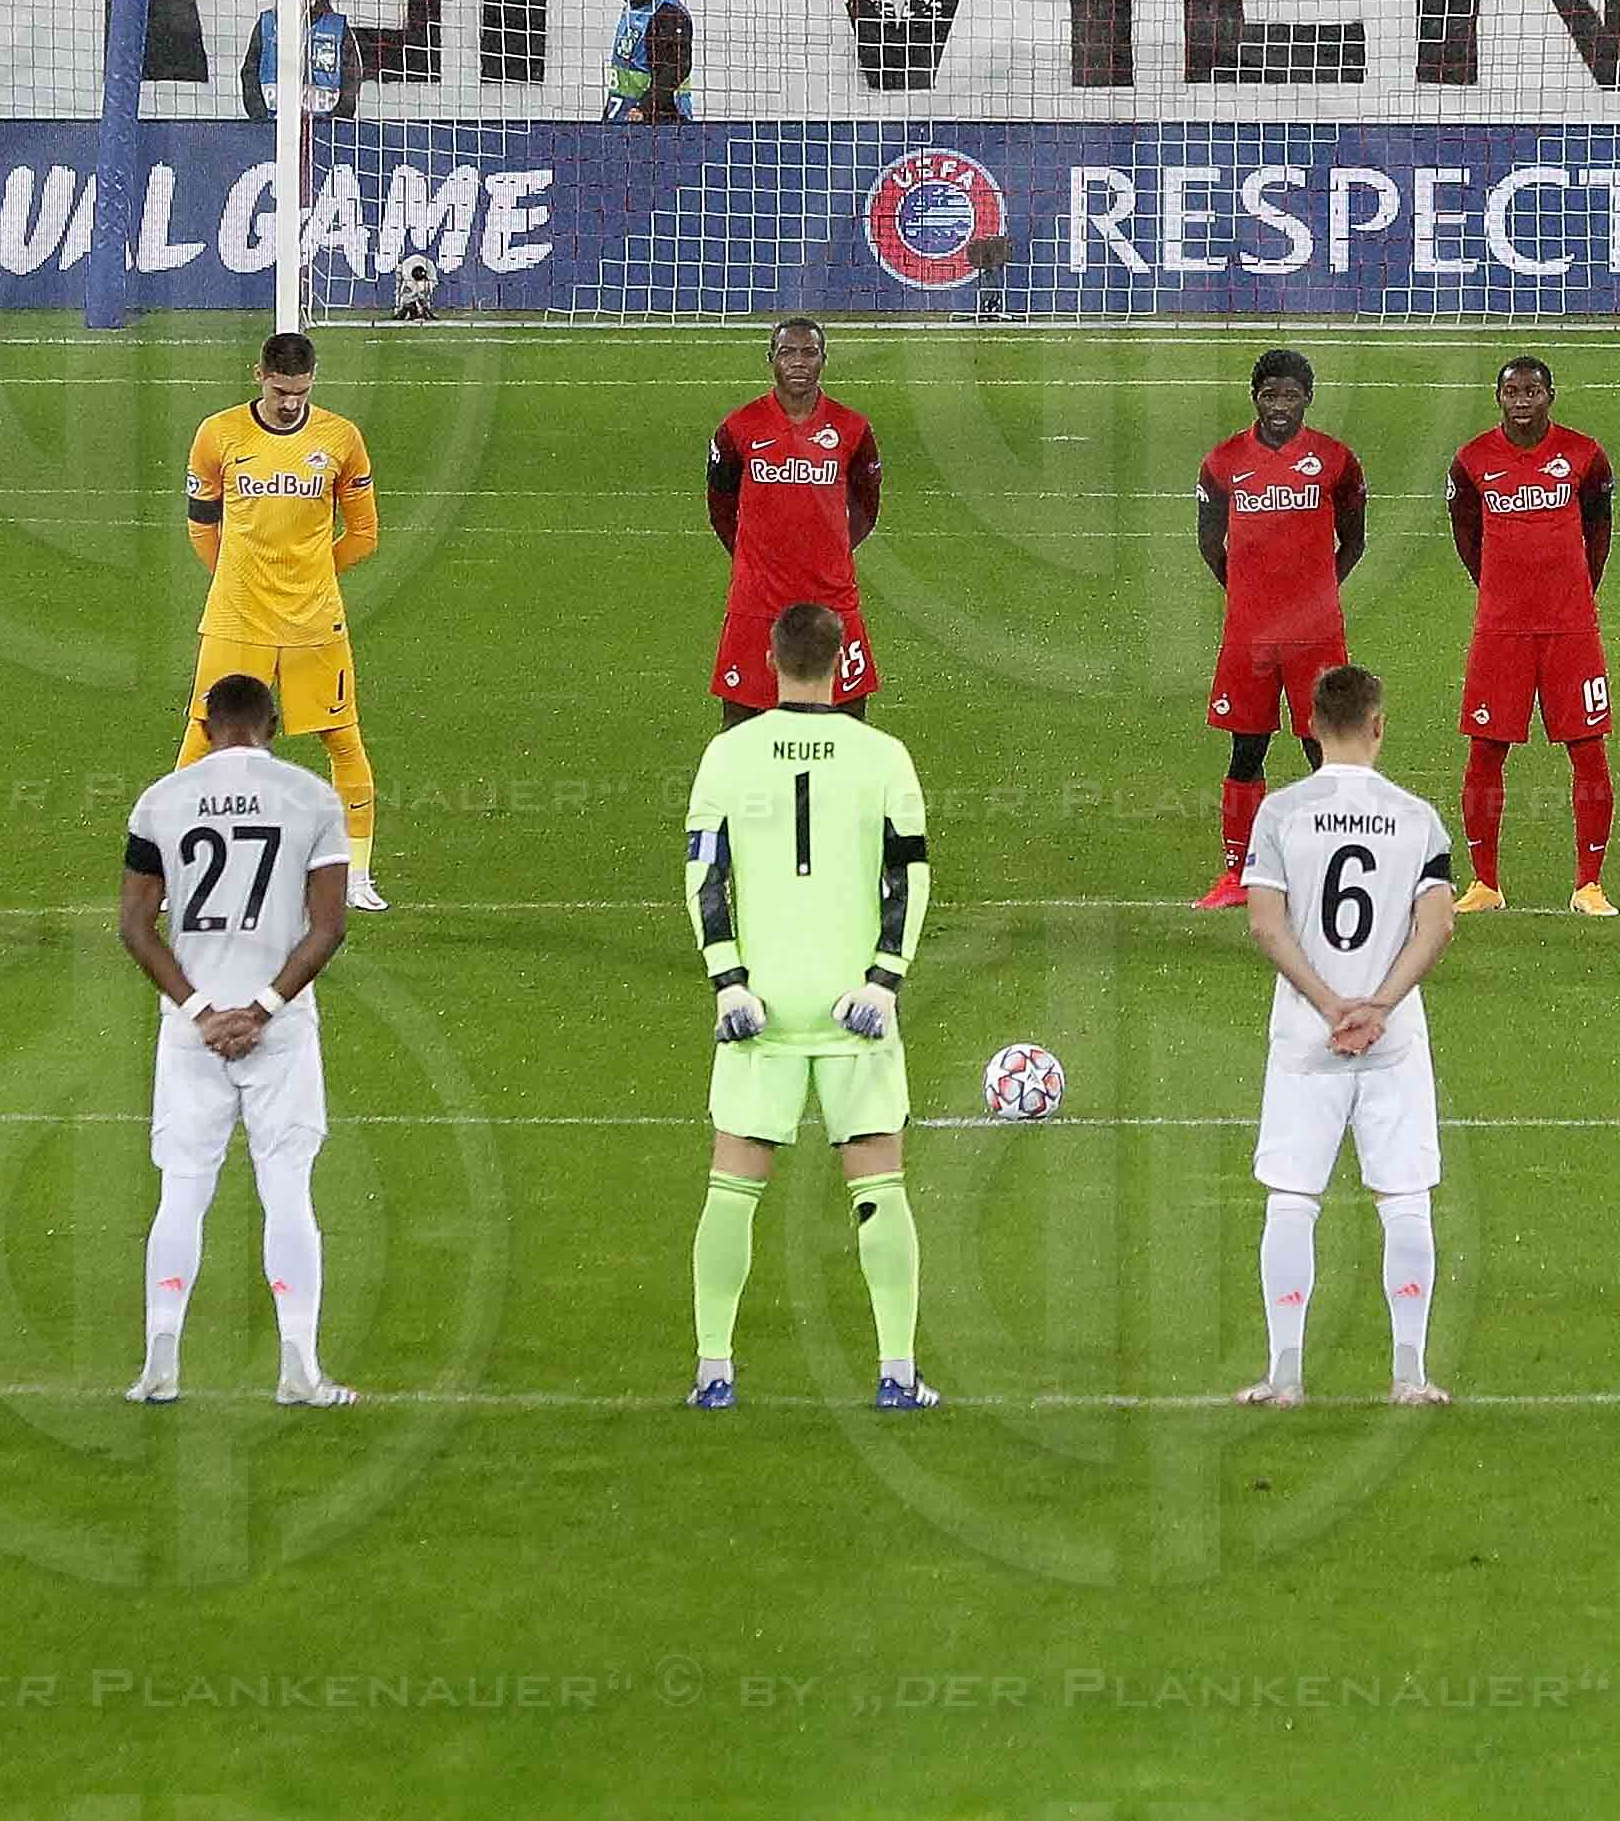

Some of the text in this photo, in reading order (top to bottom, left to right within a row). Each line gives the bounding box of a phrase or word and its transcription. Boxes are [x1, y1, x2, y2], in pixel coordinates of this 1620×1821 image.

[892, 157, 976, 191] UEFA
[336, 668, 345, 703] 1
[1581, 675, 1610, 713] 19
[772, 740, 836, 761] NEUER
[197, 795, 261, 817] ALABA
[793, 770, 812, 877] 1
[1313, 811, 1397, 837] KIMMICH
[180, 825, 282, 932] 27
[1320, 843, 1378, 952] 6
